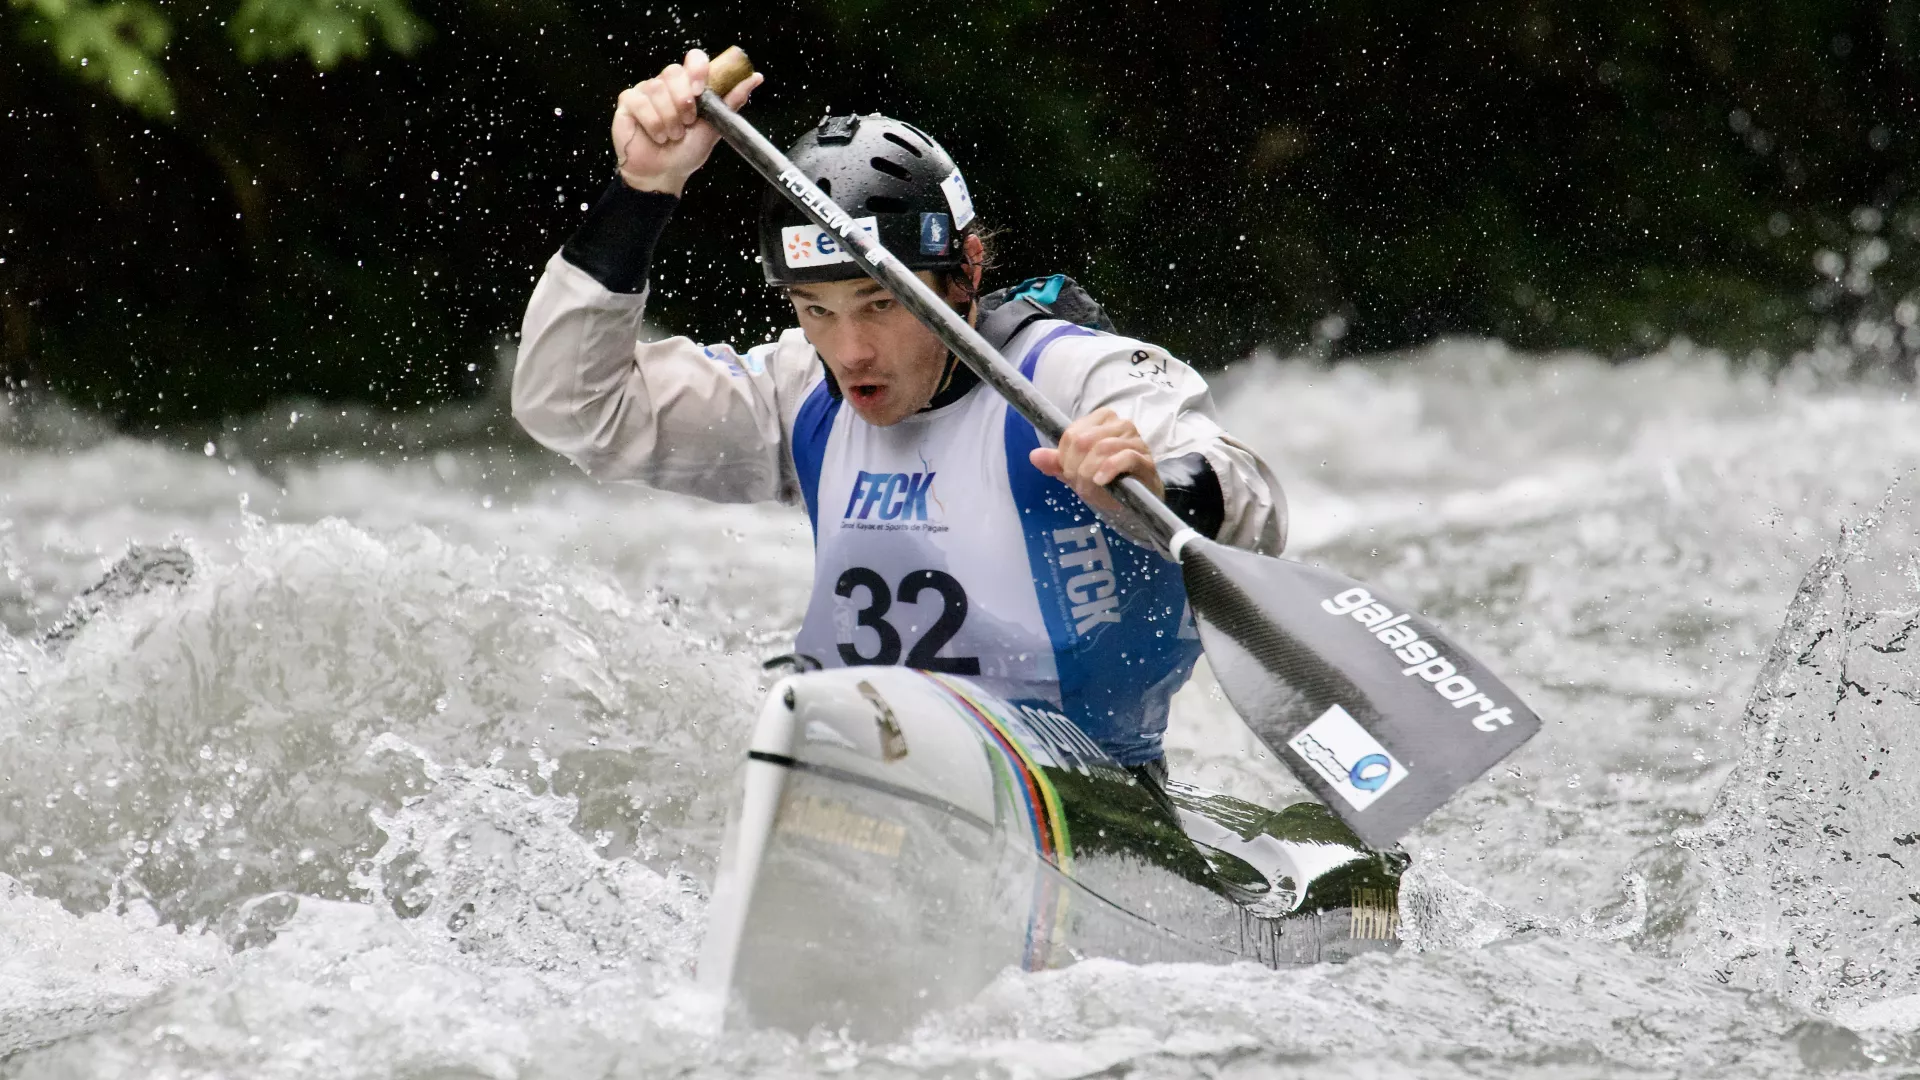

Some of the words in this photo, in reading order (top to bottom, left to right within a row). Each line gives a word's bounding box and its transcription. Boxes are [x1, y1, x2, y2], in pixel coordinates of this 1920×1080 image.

[844, 470, 937, 521] FFCK
[885, 523, 909, 532] Sports
[910, 524, 921, 532] de
[922, 524, 950, 534] Pagaie
[835, 567, 981, 676] 32
[1052, 523, 1121, 637] FFCK
[1320, 587, 1514, 733] galasport
